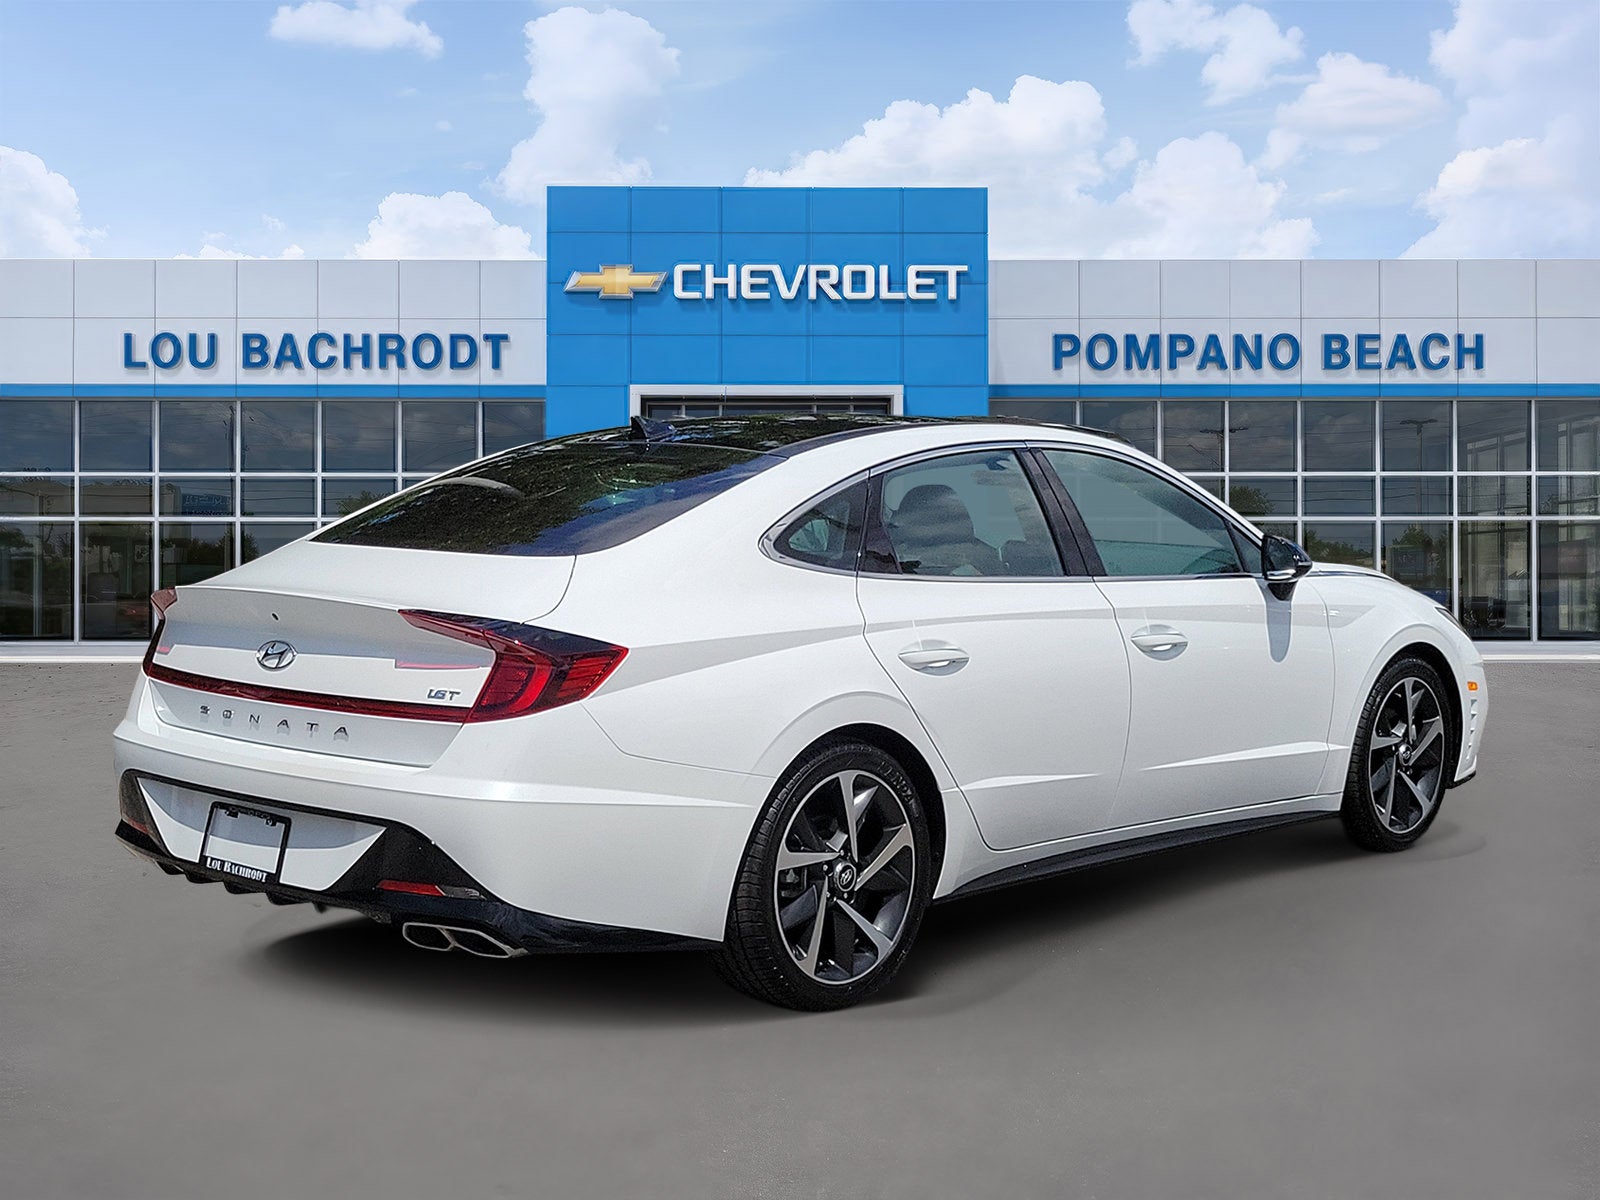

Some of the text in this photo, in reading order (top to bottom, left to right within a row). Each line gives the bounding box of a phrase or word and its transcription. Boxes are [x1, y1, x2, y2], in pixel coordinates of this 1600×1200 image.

[673, 264, 969, 301] CHEVROLET
[123, 332, 510, 371] LOU BACHRODT
[1052, 332, 1485, 371] POMPANO BEACH
[199, 704, 349, 737] SONATA
